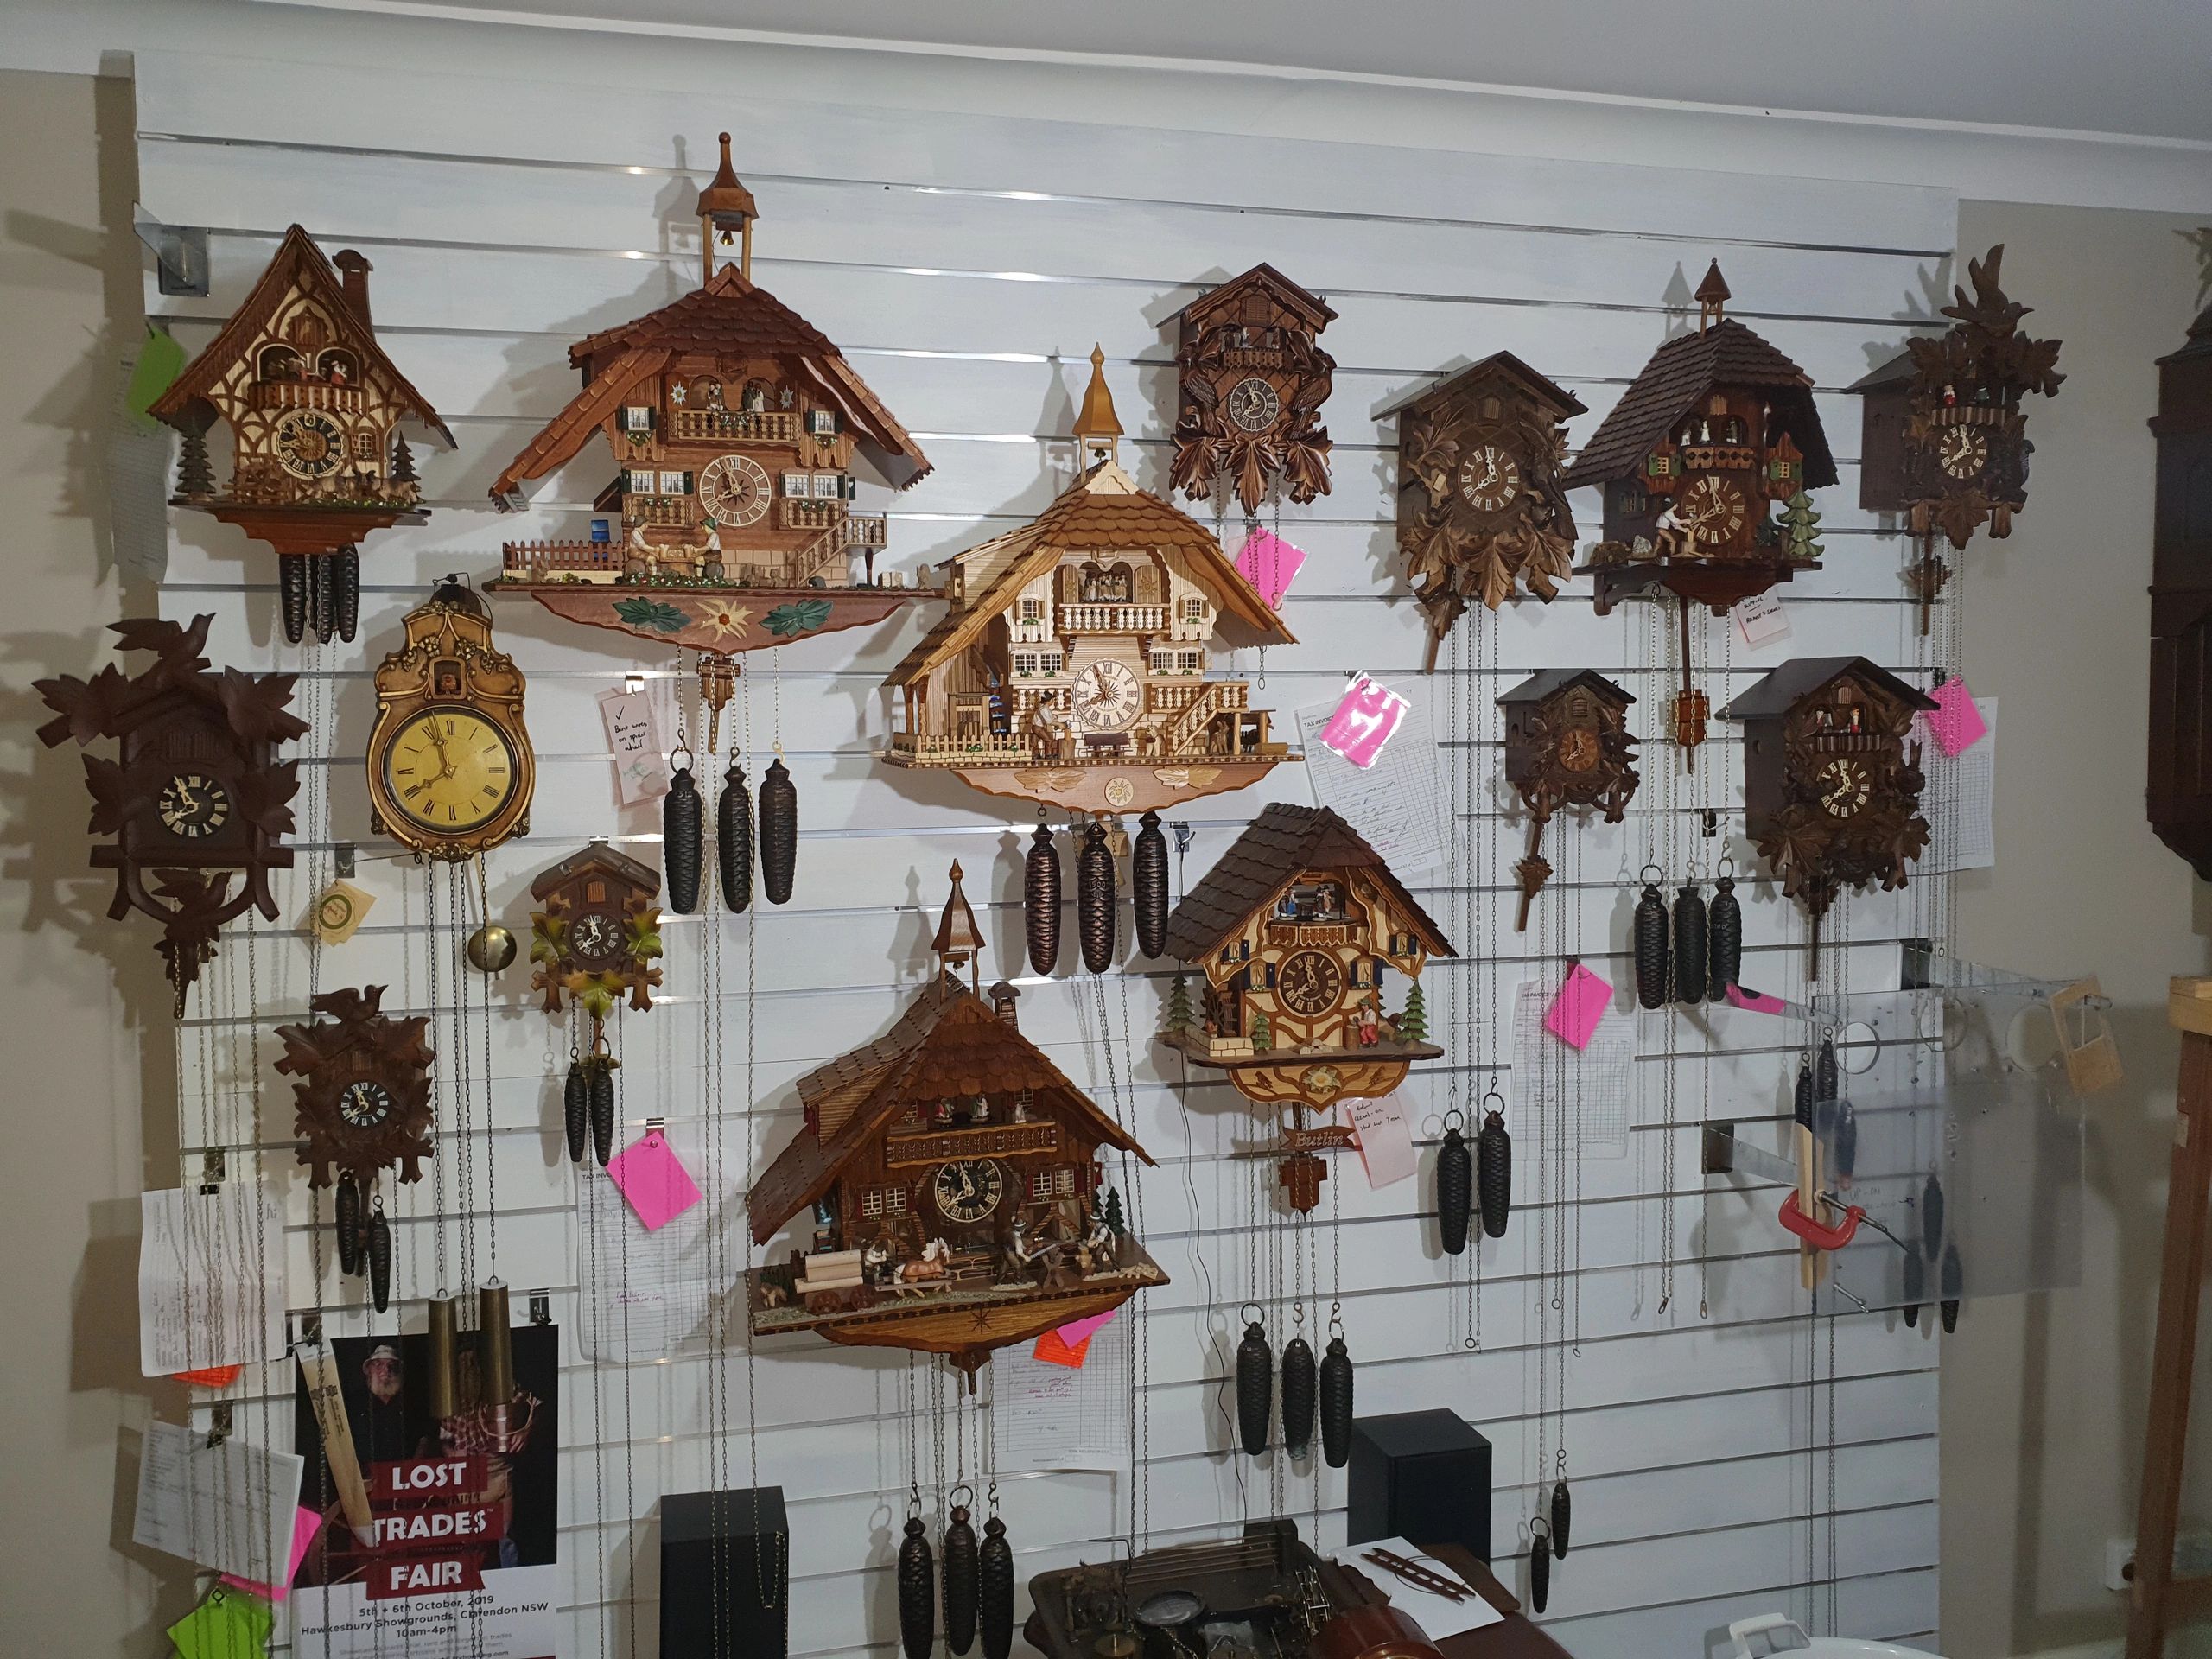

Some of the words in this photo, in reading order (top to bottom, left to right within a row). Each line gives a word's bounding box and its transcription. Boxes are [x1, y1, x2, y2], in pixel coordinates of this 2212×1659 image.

[1295, 1131, 1344, 1147] Butlin
[392, 1462, 467, 1491] LOST
[372, 1510, 486, 1541] TRADES
[391, 1560, 462, 1591] FAIR
[301, 1620, 374, 1636] Hawkesbury
[375, 1612, 457, 1628] Showgrounds,
[521, 1602, 549, 1613] NSW
[359, 1606, 378, 1618] 5th
[391, 1603, 411, 1615] 6th
[415, 1598, 464, 1612] October,
[467, 1595, 494, 1606] 2019
[396, 1624, 457, 1639] 10am-4pm
